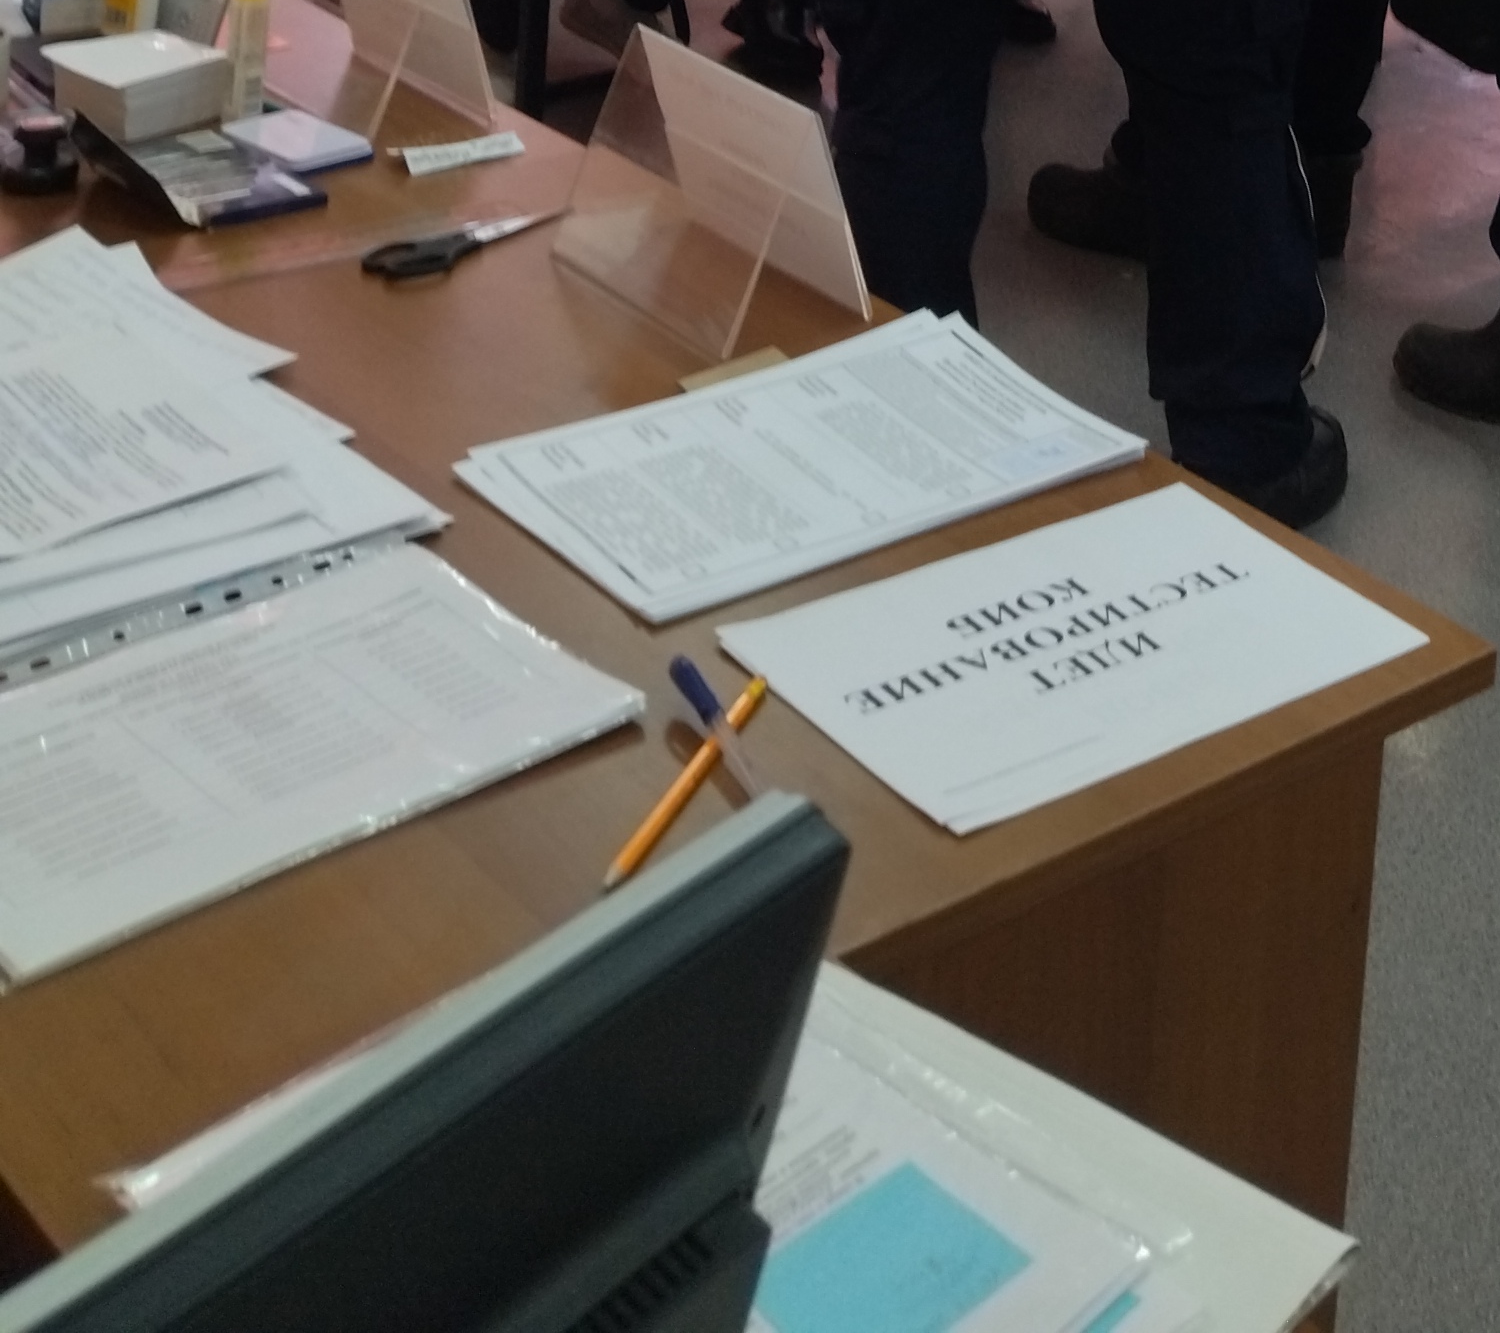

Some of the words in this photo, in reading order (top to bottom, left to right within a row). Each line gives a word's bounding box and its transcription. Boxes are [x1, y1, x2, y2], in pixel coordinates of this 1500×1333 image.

[842, 562, 1250, 717] ТЕСТИРОВАНИЕ
[945, 576, 1091, 641] КОИБ
[1026, 631, 1162, 696] ИДЕТ
